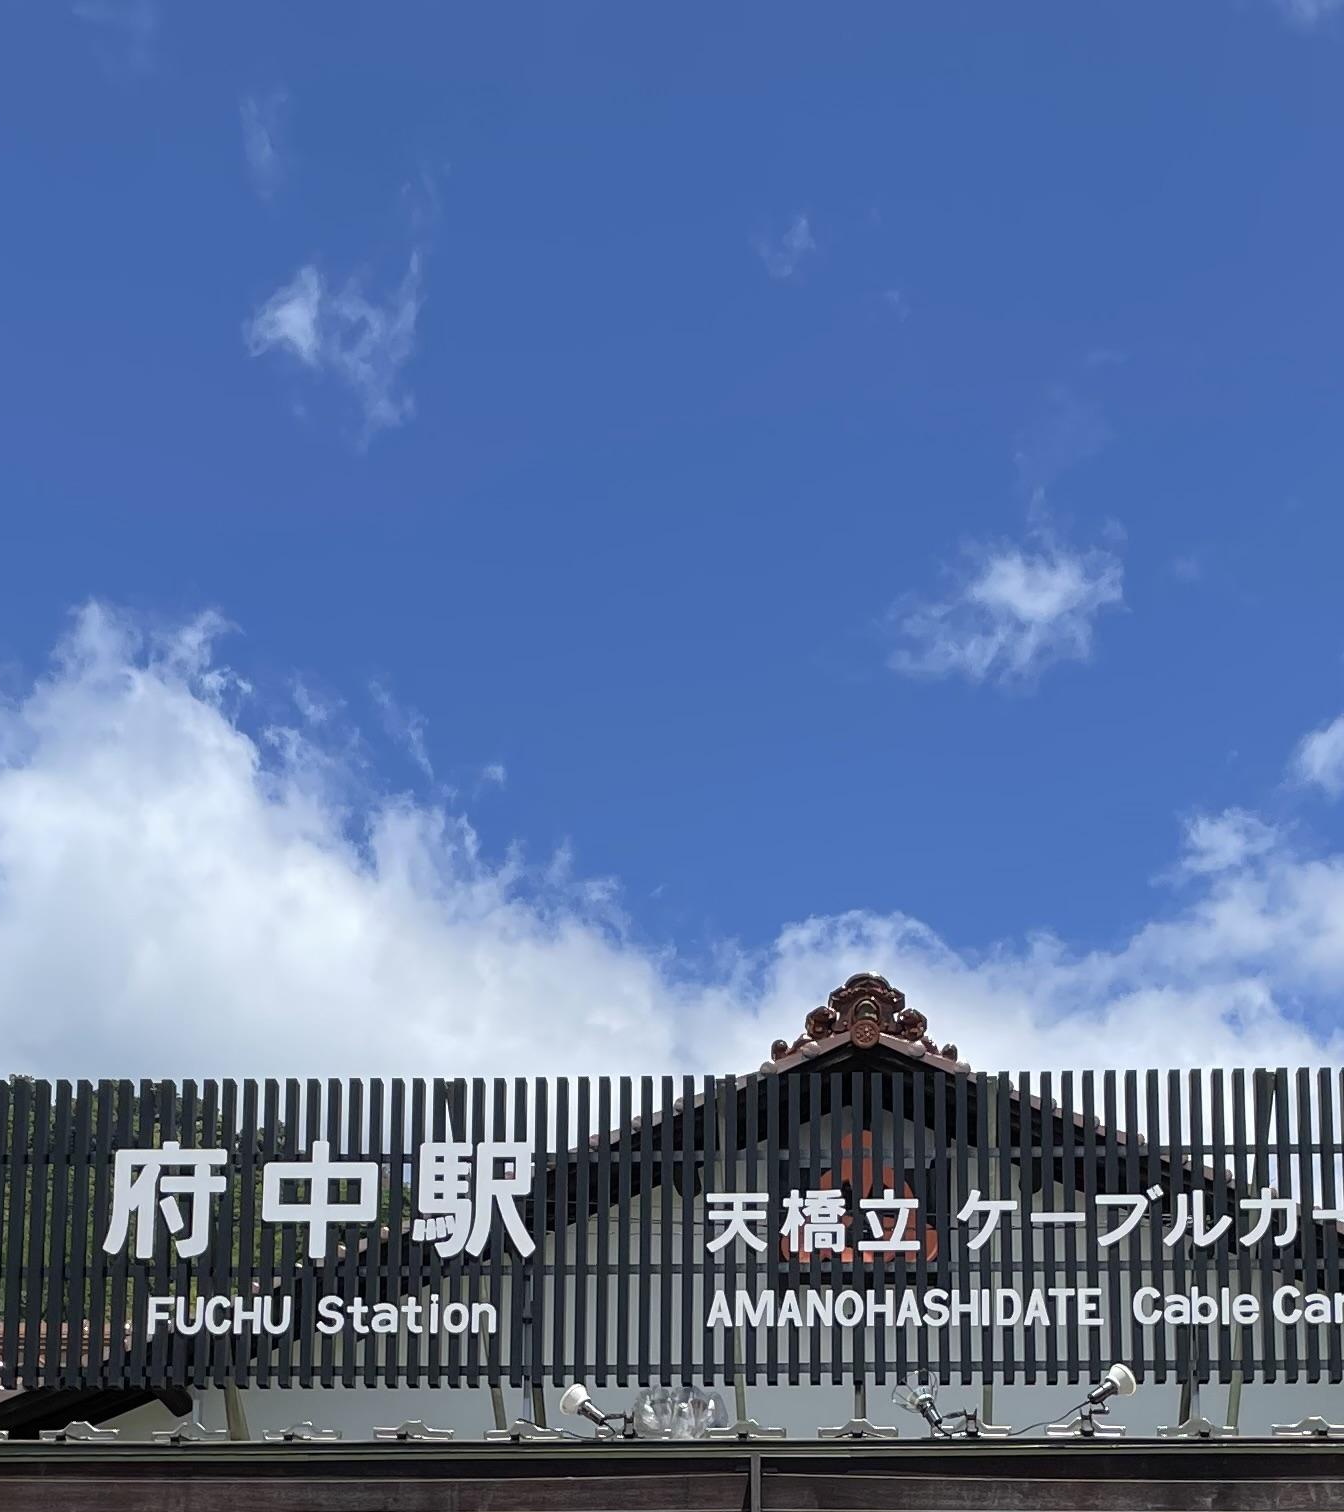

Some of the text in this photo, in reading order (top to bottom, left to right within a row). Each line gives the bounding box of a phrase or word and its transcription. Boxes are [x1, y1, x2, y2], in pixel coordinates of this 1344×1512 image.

[102, 1140, 537, 1259] 府中駅
[705, 1188, 922, 1254] 天橋立
[147, 1293, 498, 1335] FUCHU Station
[706, 1287, 1105, 1328] AMANOHASHIDATE
[1132, 1285, 1260, 1326] Cable
